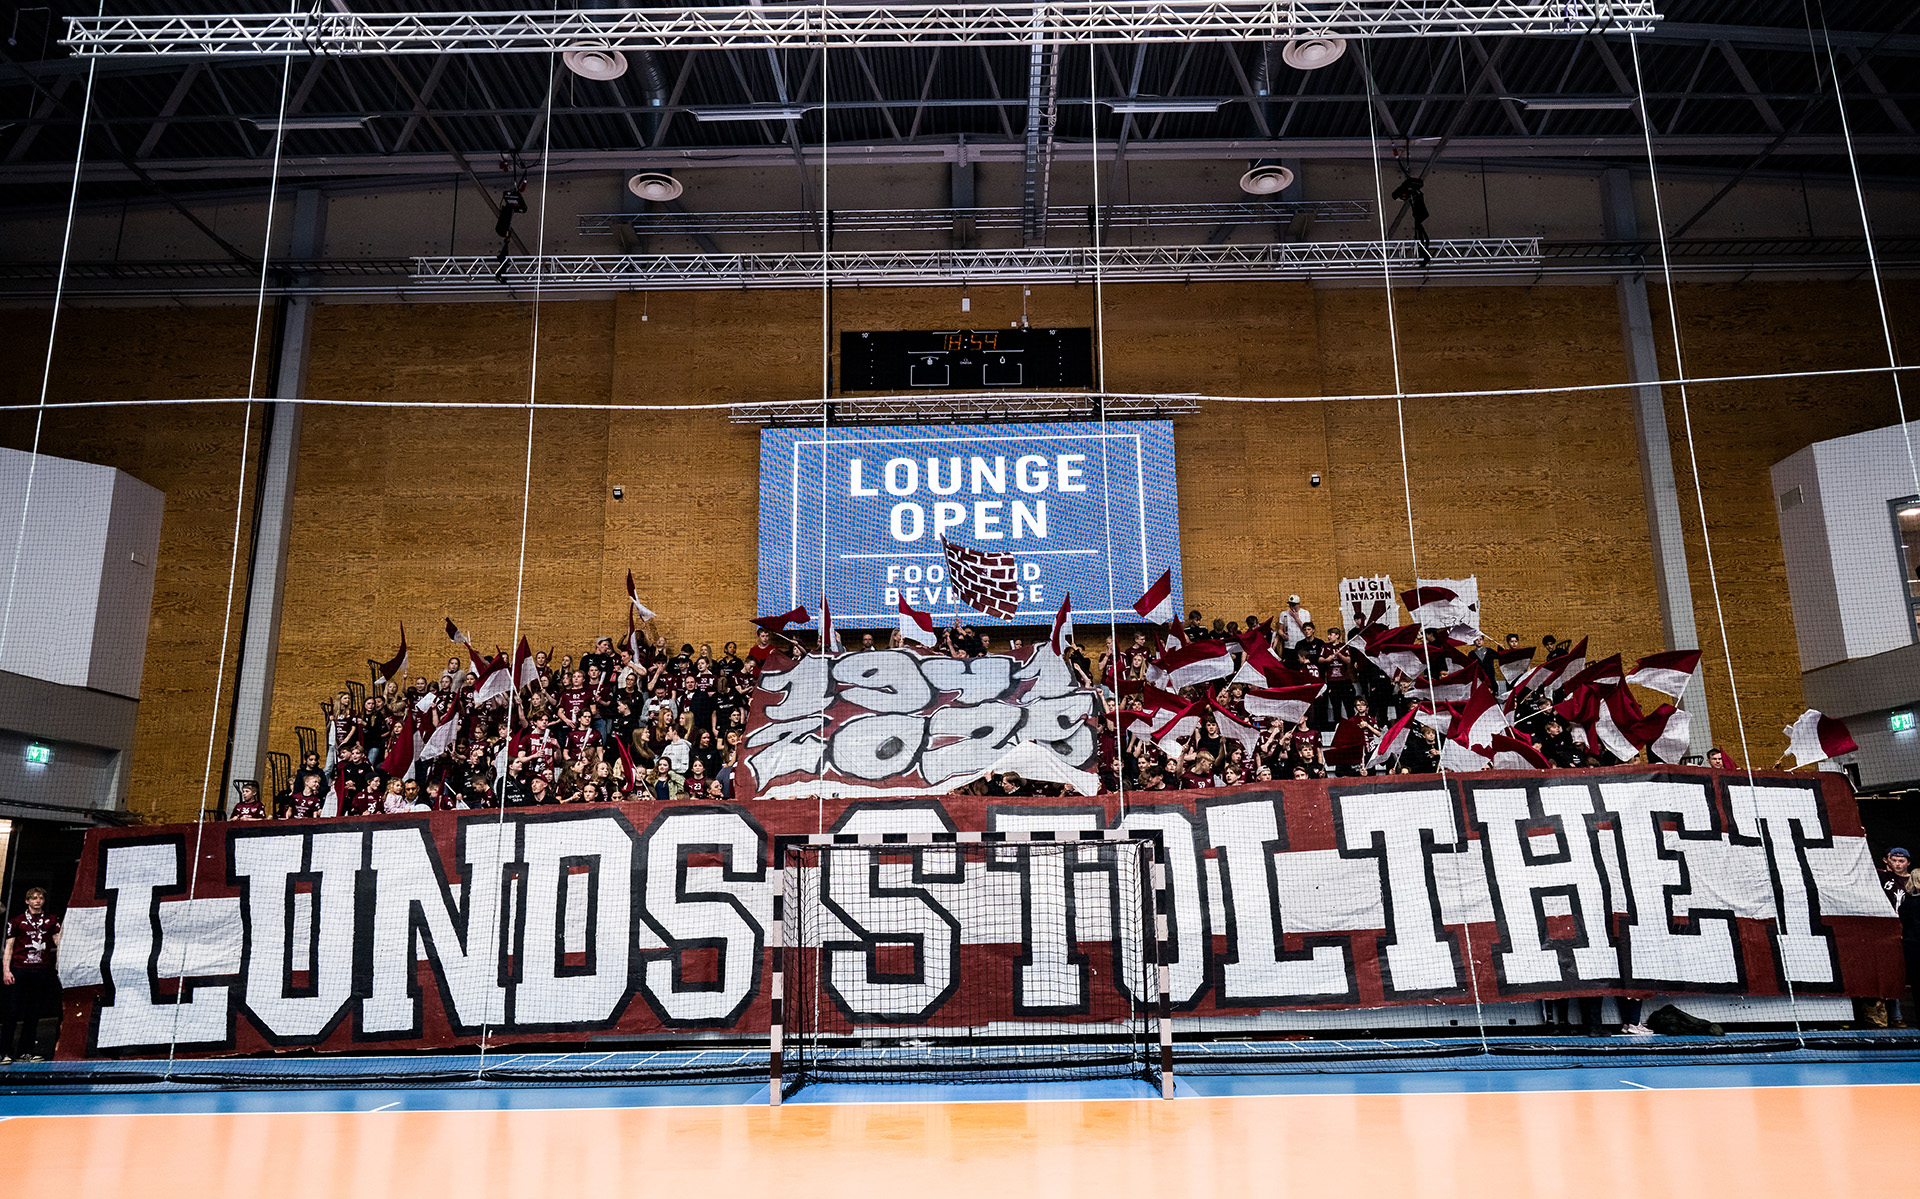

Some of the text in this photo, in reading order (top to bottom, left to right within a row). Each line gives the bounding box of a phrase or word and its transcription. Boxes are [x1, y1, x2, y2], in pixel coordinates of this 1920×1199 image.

[944, 334, 998, 351] 18:54
[849, 453, 1088, 498] LOUNGE
[889, 499, 1047, 542] OPEN
[1345, 590, 1392, 601] INVASION
[1348, 580, 1386, 592] LUGI
[756, 640, 1080, 722] 1941
[92, 777, 1840, 1050] LUNDS STOLTHET
